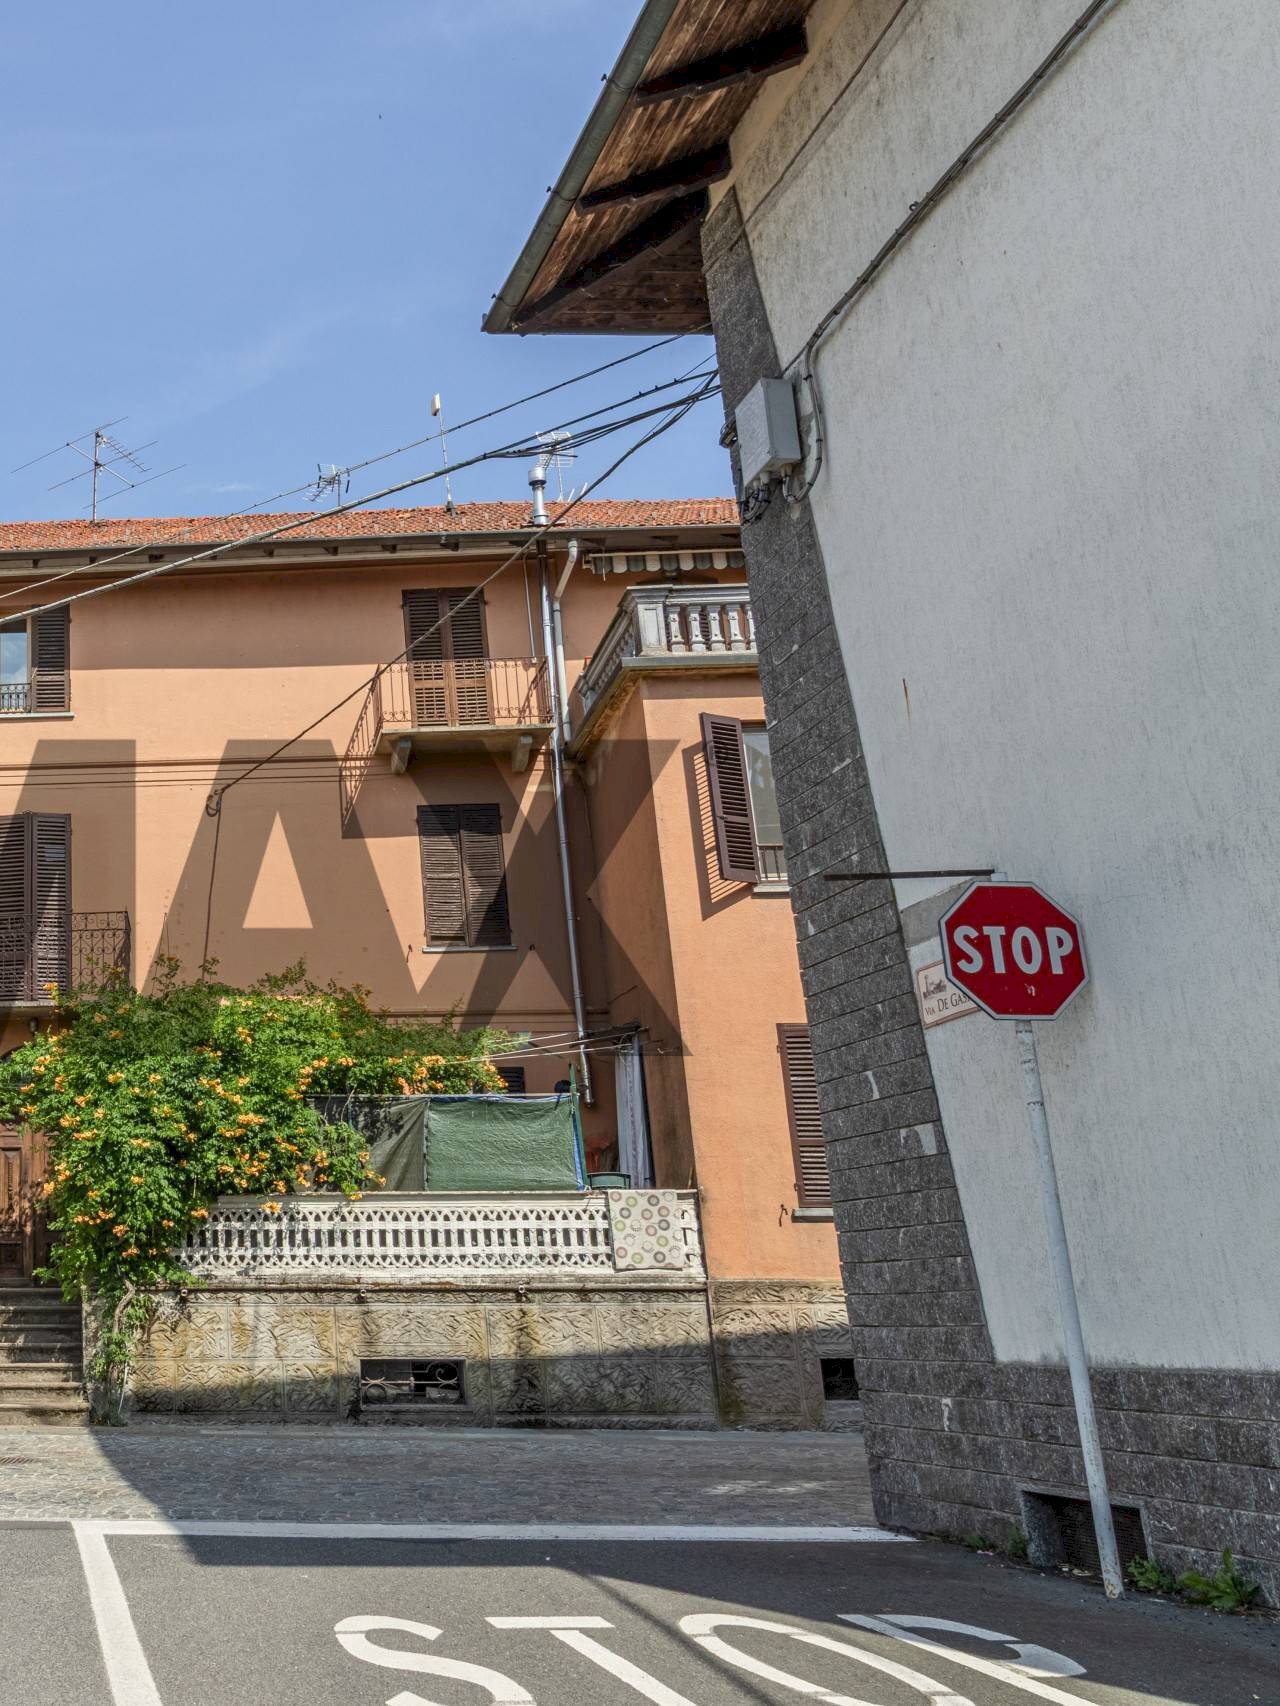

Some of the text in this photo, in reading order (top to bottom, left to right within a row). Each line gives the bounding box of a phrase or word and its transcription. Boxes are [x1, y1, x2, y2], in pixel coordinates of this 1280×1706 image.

[953, 925, 1073, 975] STOP
[937, 998, 949, 1012] DE
[950, 993, 970, 1007] GAS
